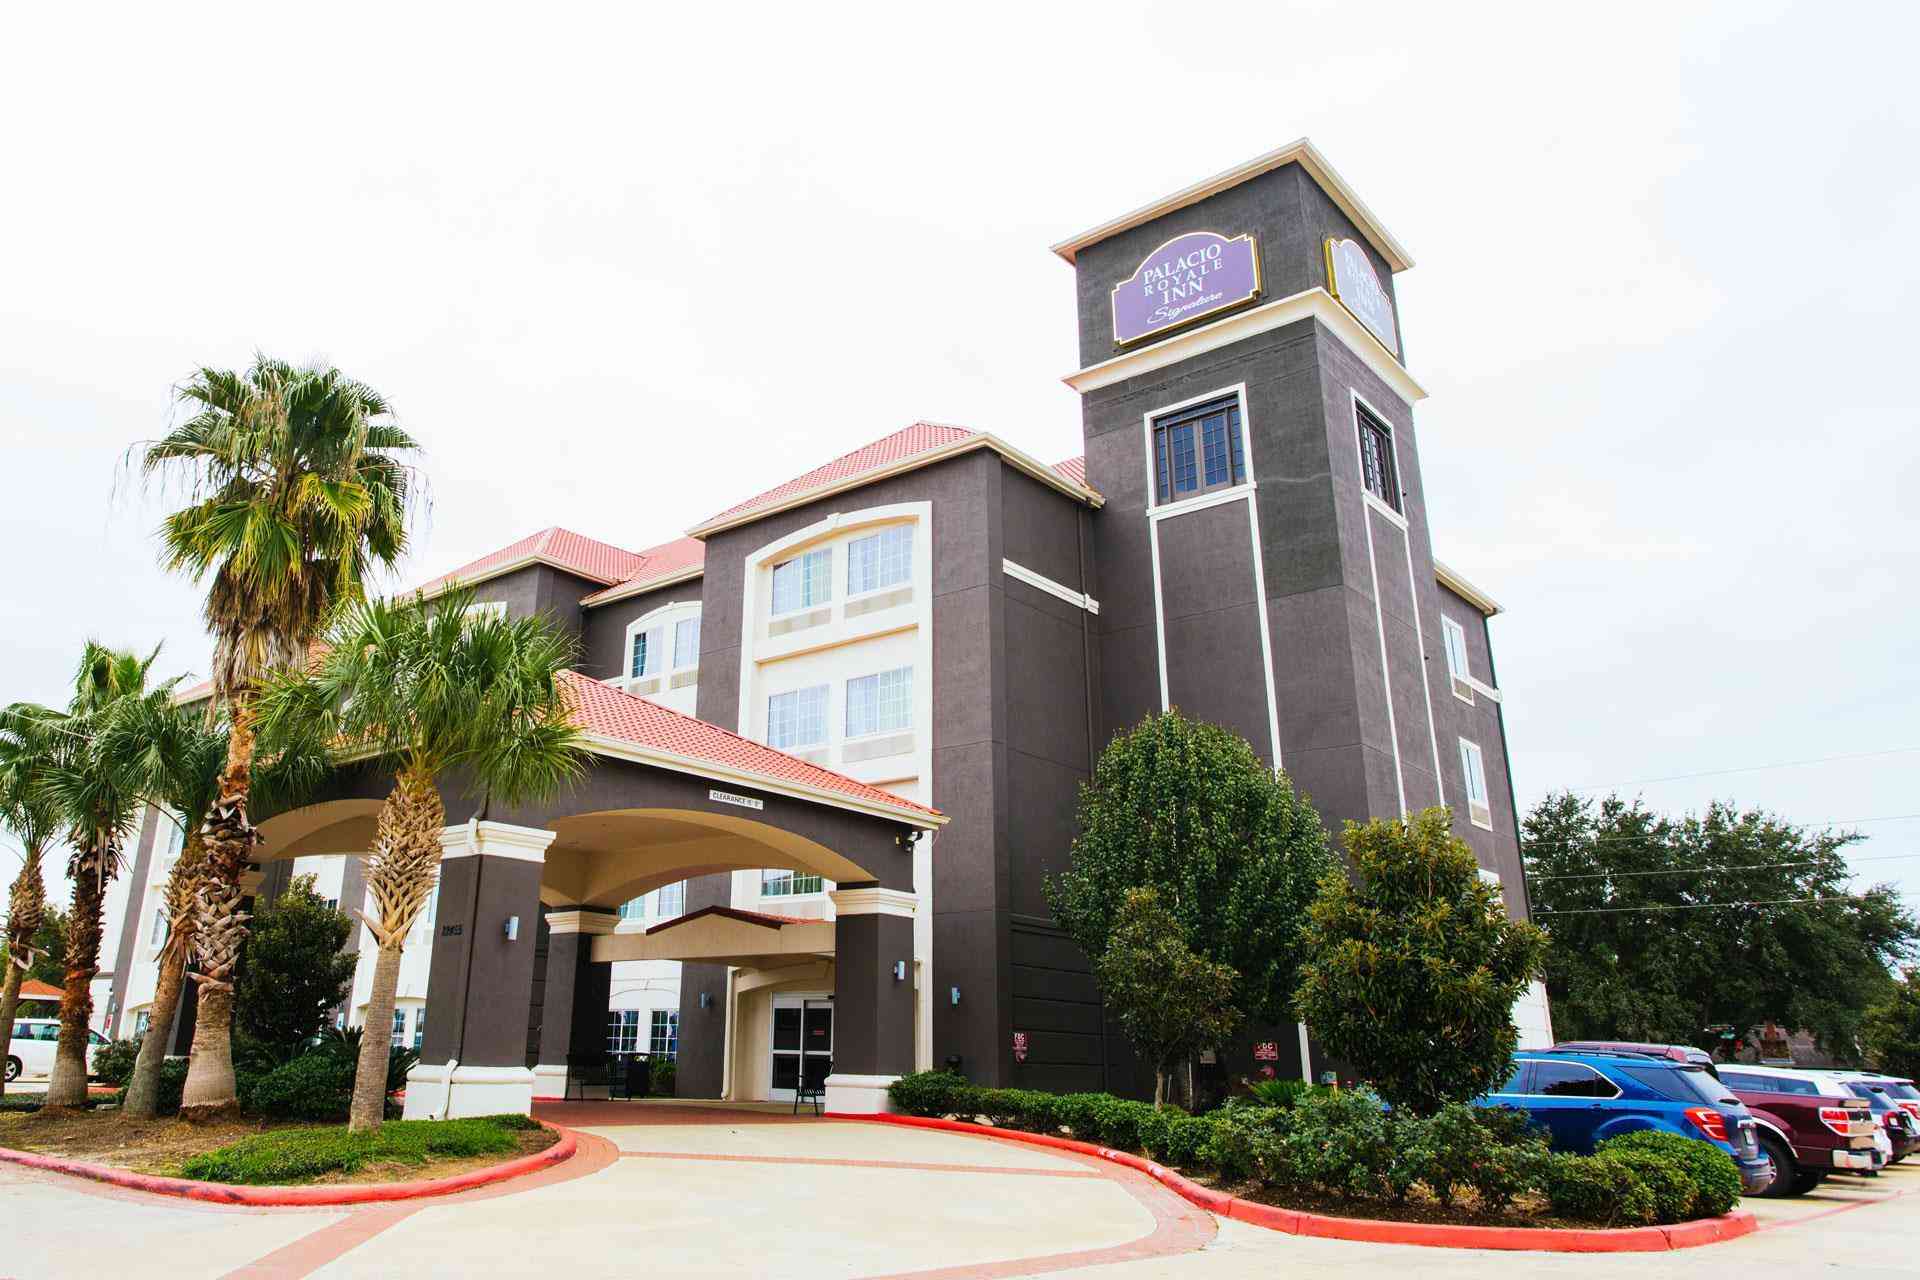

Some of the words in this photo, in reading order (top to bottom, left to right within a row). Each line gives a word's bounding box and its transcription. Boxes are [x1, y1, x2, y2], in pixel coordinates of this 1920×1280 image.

[1143, 243, 1222, 286] PALACIO
[1143, 259, 1224, 297] ROYALE
[1163, 277, 1204, 306] INN
[1147, 292, 1223, 325] Signature
[712, 791, 746, 806] CLEARANCE
